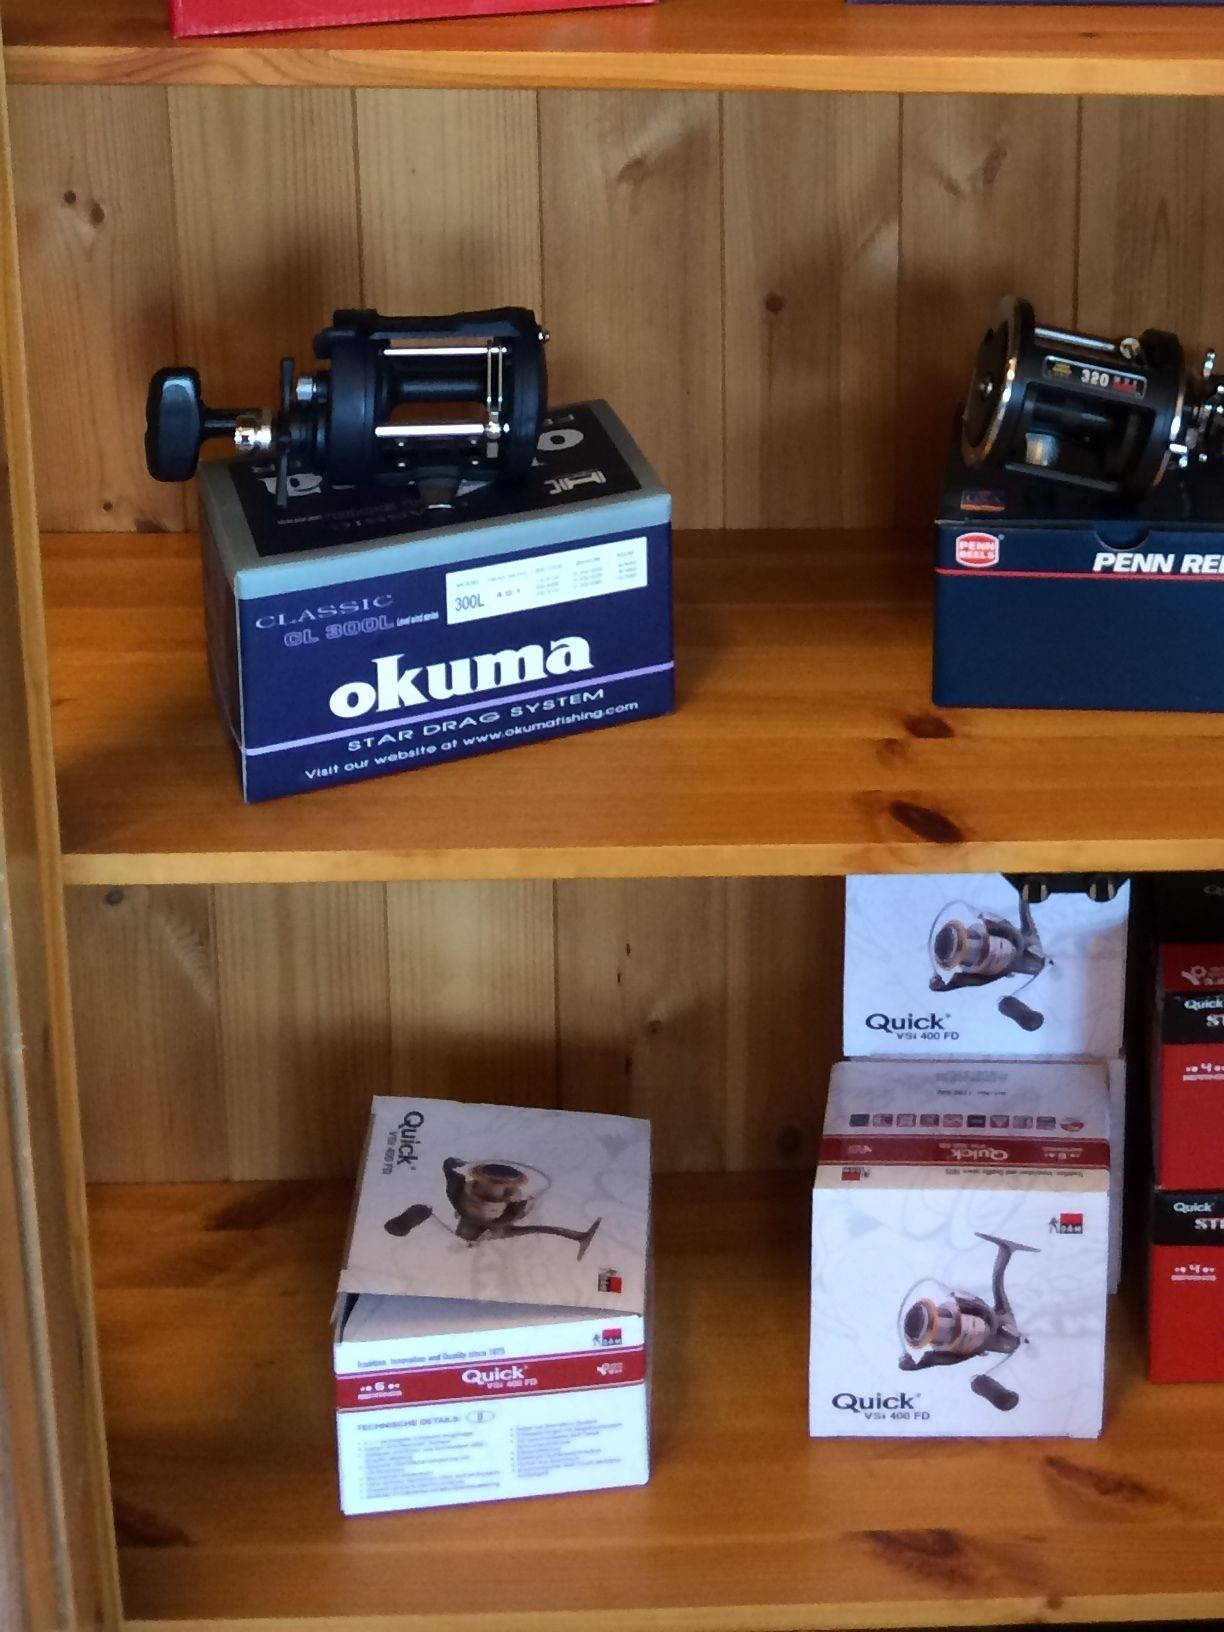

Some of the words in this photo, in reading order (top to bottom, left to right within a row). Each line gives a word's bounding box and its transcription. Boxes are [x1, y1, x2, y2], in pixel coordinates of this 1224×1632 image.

[1081, 369, 1109, 387] 320
[1092, 552, 1175, 573] PENN
[255, 594, 393, 629] CLASSIC
[455, 593, 485, 612] 300L
[325, 615, 395, 640] 300L
[329, 636, 595, 718] okuma
[348, 729, 414, 752] STAR
[423, 712, 501, 737] DRAG
[510, 689, 604, 717] SYSTEM
[305, 764, 339, 780] Visit
[344, 758, 369, 771] our
[374, 744, 437, 766] website
[441, 738, 458, 751] at
[1184, 999, 1224, 1011] Quick
[865, 1013, 945, 1034] Quick
[919, 1032, 941, 1041] 400
[943, 1032, 960, 1041] FD
[397, 1111, 424, 1165] Quick
[950, 1147, 1009, 1162] Quick
[1173, 1202, 1213, 1213] Quick
[461, 1365, 527, 1386] Quick
[832, 1392, 915, 1414] Quick
[914, 1412, 931, 1421] FD
